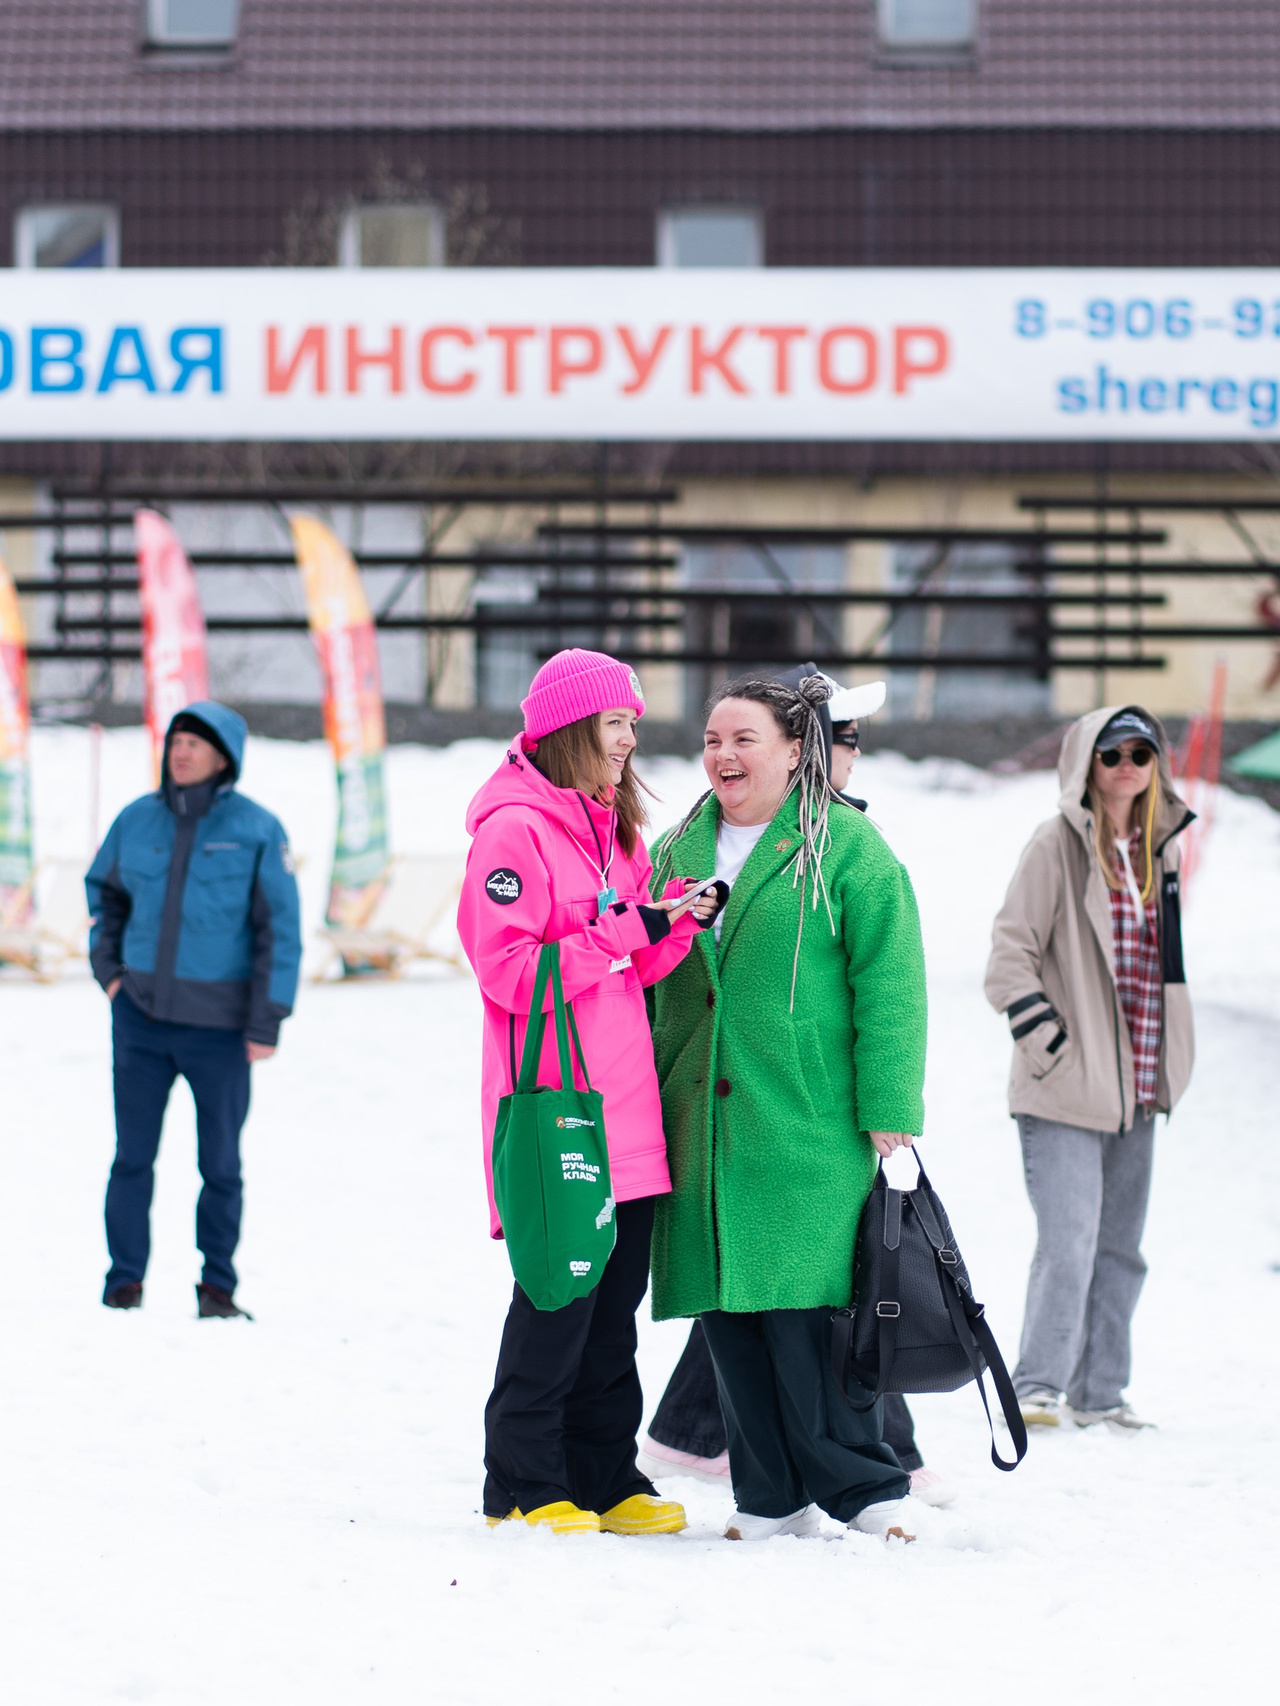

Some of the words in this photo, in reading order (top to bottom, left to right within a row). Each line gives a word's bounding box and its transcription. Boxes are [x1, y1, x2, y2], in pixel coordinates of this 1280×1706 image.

[0, 325, 222, 393] ВАЯ
[266, 325, 951, 395] ИНСТРУКТОР
[561, 1153, 584, 1161] МОЯ
[562, 1162, 600, 1174] РУЧНАЯ
[563, 1171, 596, 1182] КЛАДЬ
